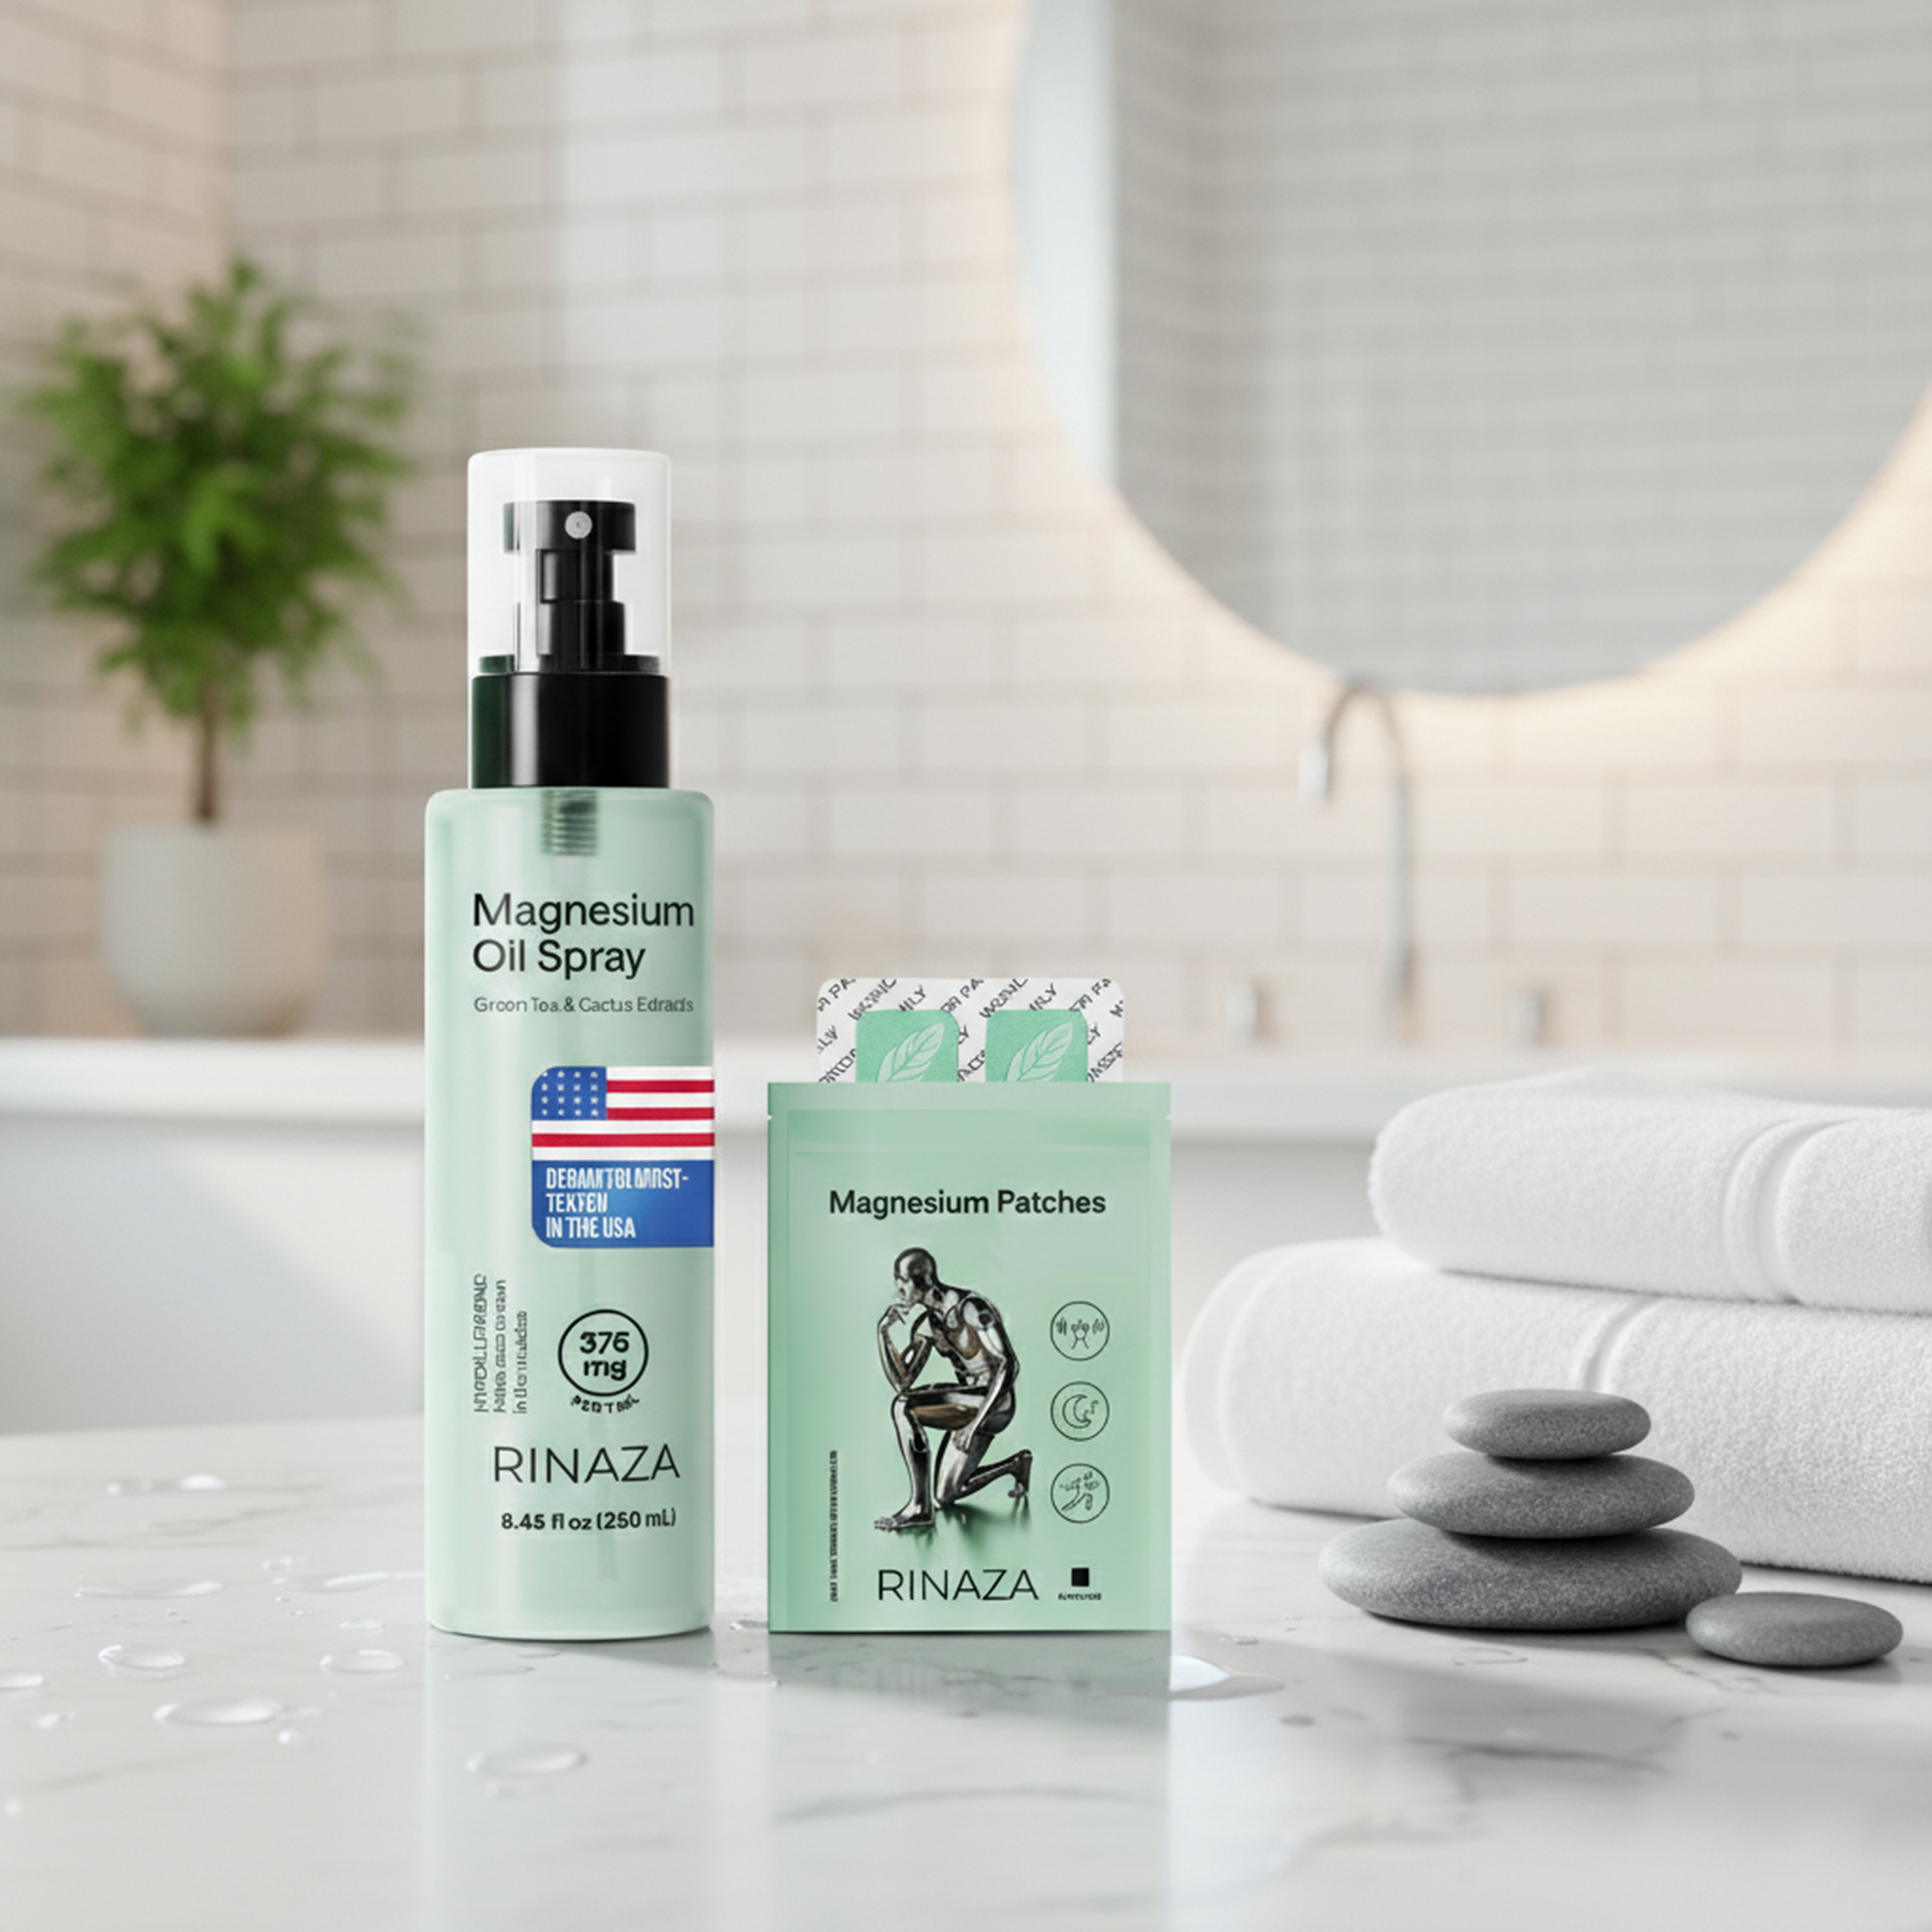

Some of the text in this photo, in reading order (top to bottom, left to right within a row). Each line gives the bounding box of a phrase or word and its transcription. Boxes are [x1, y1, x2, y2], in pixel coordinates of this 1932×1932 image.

[474, 893, 694, 934] Magnesium
[473, 939, 646, 980] Oil Spray
[563, 996, 576, 1013] &
[579, 996, 632, 1013] Cactus
[830, 1188, 1106, 1219] Magnesium Patches
[546, 1216, 562, 1239] IN
[603, 1216, 636, 1239] USA
[584, 1359, 626, 1381] mg
[494, 1444, 681, 1483] RINAZA
[501, 1506, 677, 1531] 8.45 fl oz (250 mL)
[879, 1569, 1039, 1600] RINAZA
